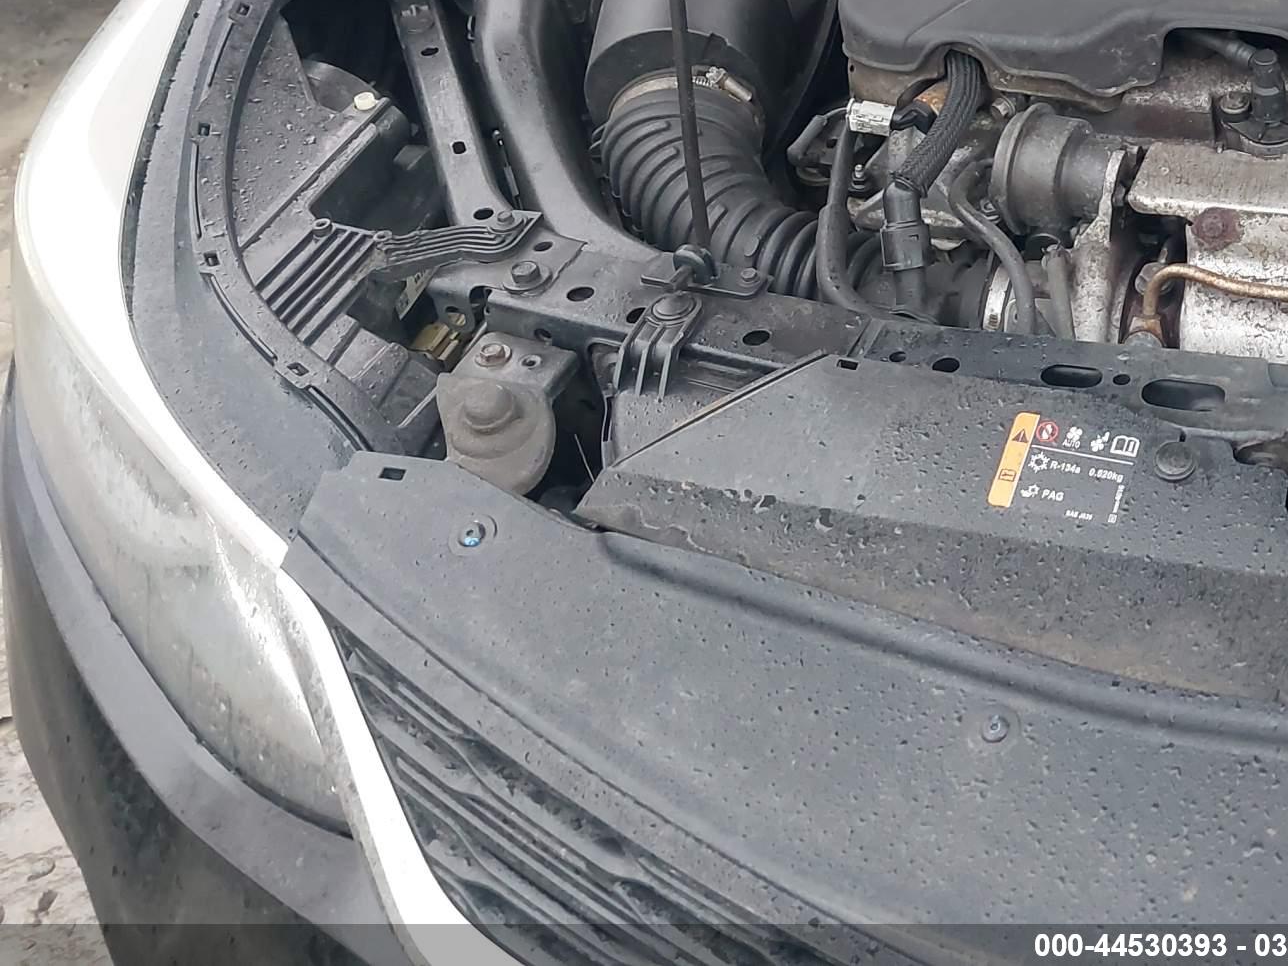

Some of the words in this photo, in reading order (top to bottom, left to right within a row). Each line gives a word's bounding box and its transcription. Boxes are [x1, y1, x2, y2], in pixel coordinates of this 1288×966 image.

[1062, 438, 1081, 449] AUTO
[1050, 460, 1081, 475] R-134a
[1041, 488, 1065, 502] PAG
